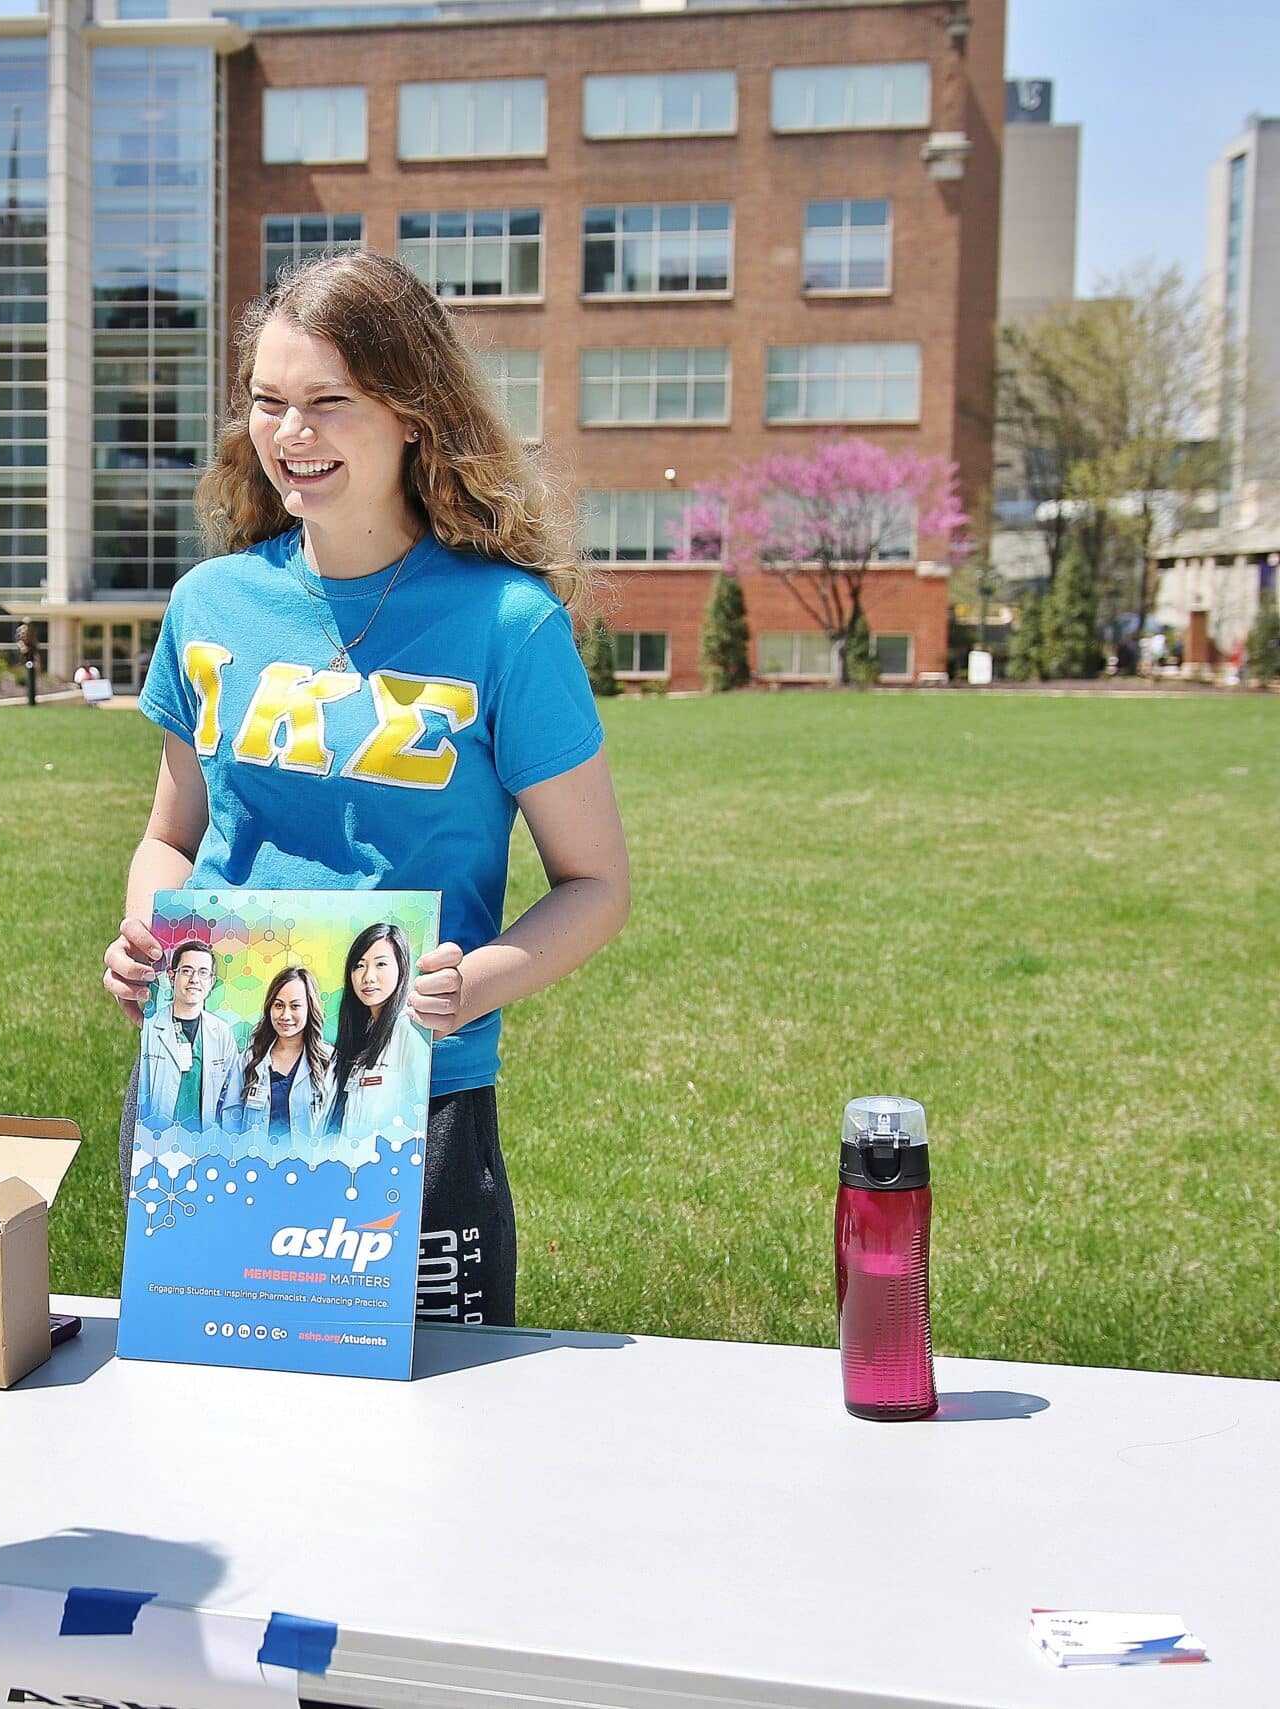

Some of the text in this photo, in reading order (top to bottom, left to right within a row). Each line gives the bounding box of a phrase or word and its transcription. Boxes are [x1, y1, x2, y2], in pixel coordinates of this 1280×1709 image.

[271, 1217, 393, 1273] ashp
[243, 1268, 391, 1288] MEMBERSHIP MATTERS
[148, 1283, 185, 1295] Engaging
[224, 1288, 258, 1300] Inspiring
[310, 1295, 353, 1307] Advancing
[355, 1298, 389, 1308] Practice.
[298, 1331, 387, 1347] ashp.org/students
